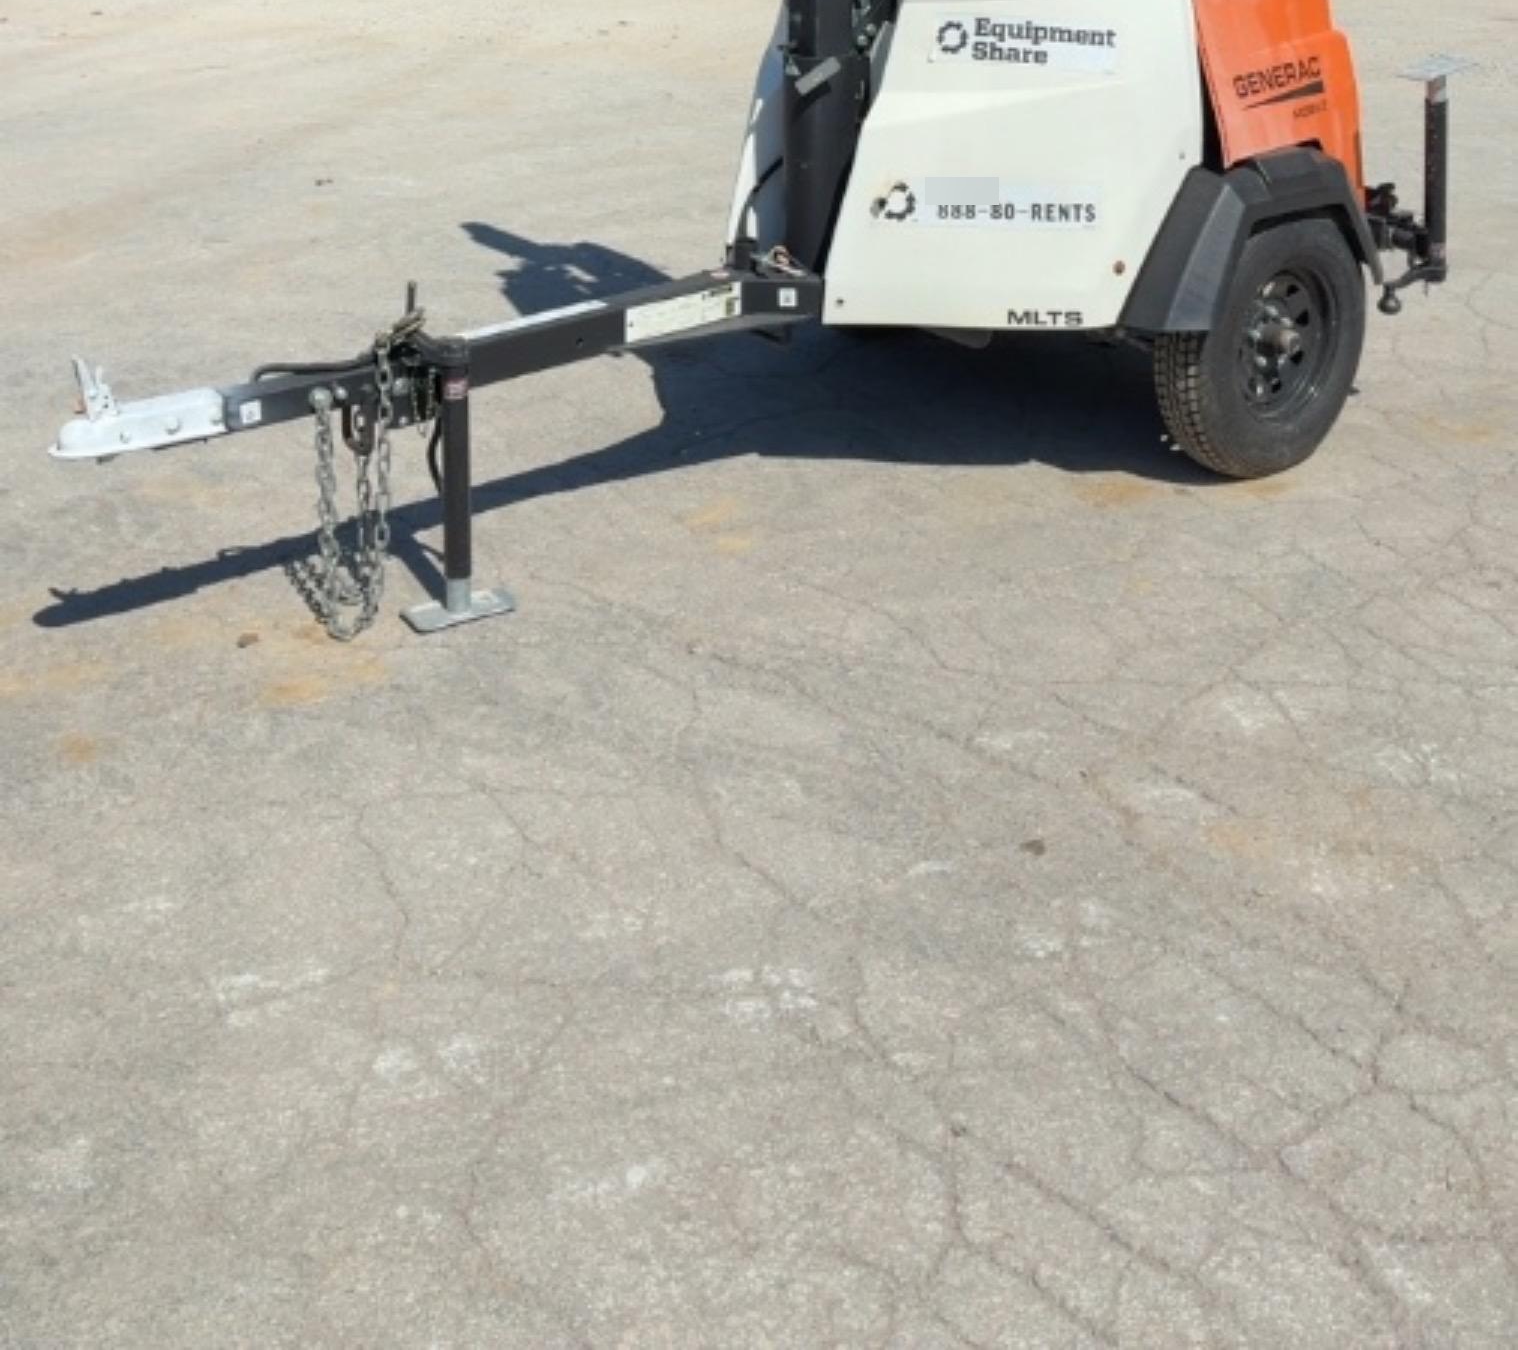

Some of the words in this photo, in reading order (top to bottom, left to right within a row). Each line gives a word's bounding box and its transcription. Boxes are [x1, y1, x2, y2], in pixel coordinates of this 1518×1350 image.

[974, 16, 1117, 47] Equipment
[971, 41, 1048, 64] Share
[1232, 56, 1322, 99] GENERAC
[937, 202, 1096, 224] 888-80-RENTS
[1006, 309, 1084, 326] MLTS
